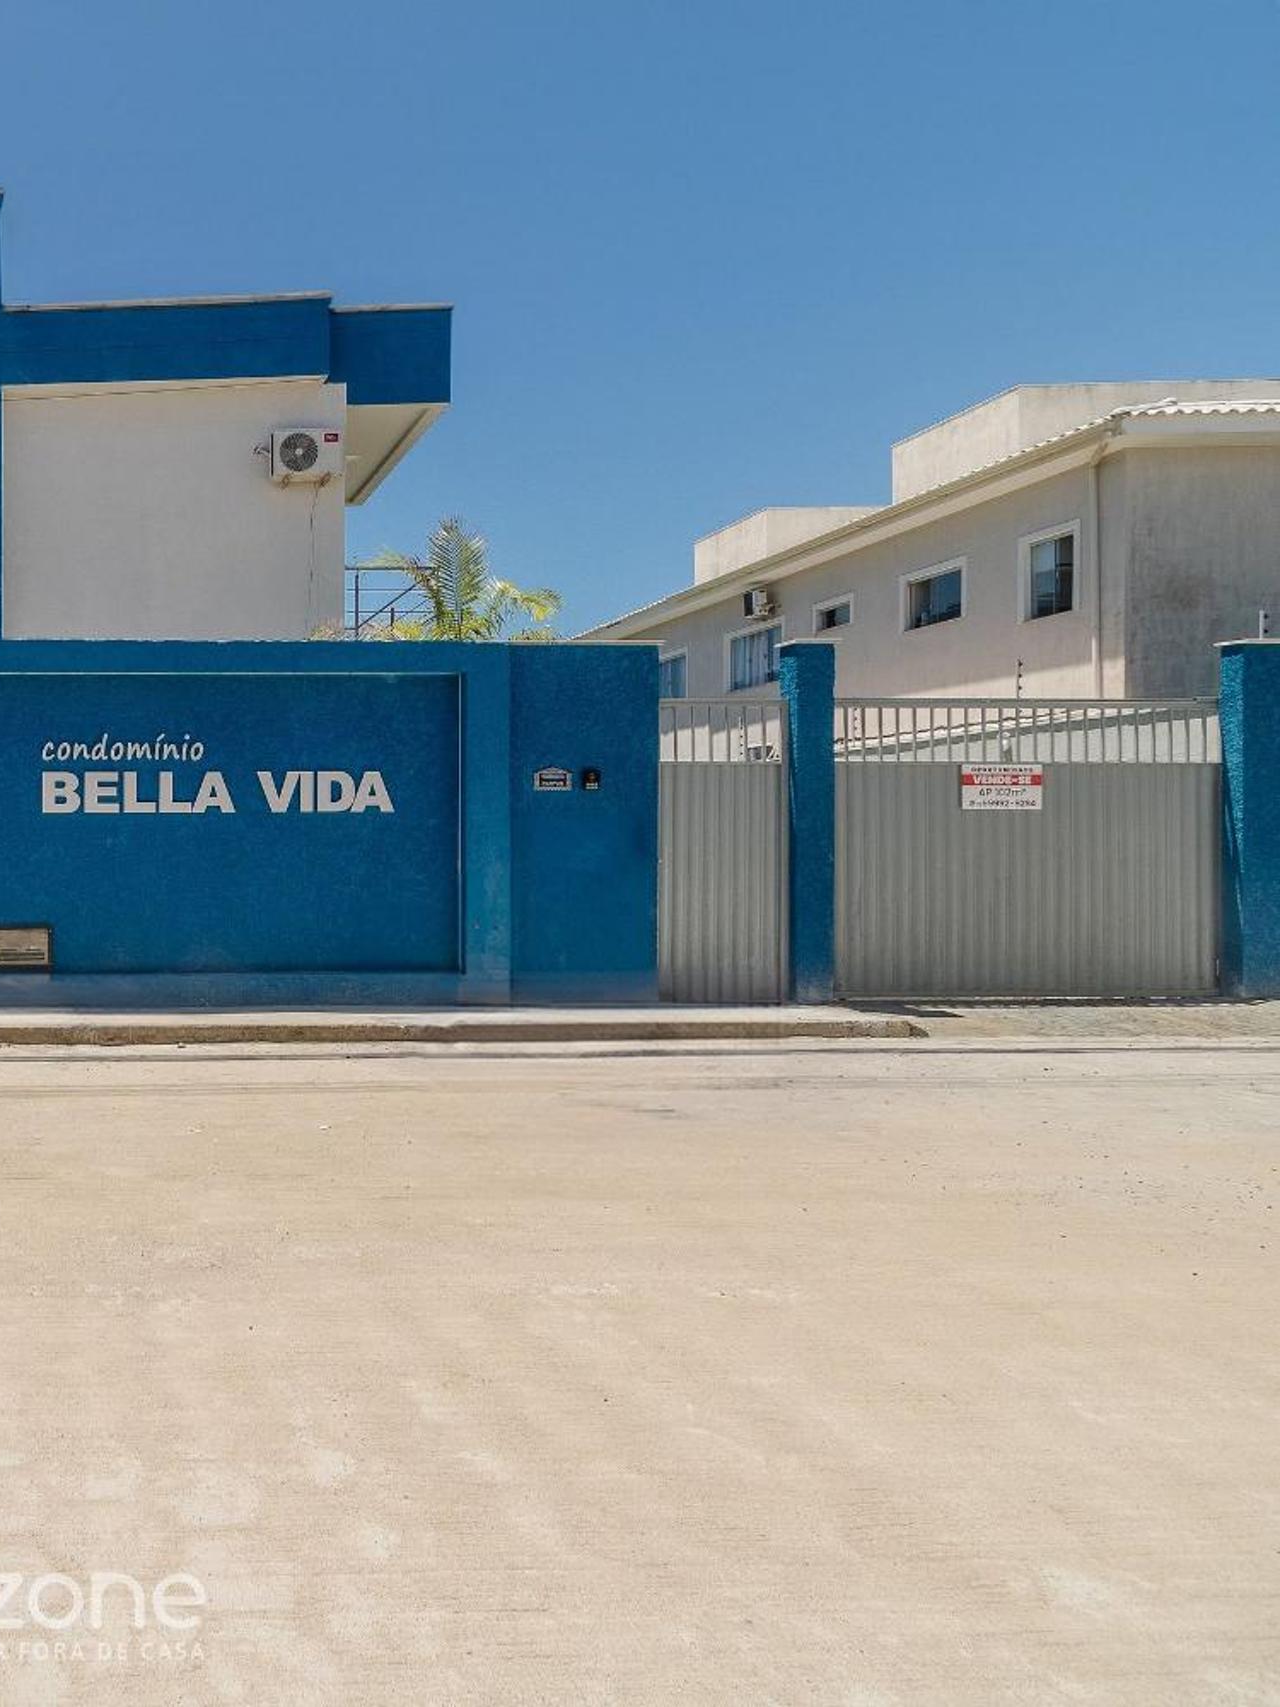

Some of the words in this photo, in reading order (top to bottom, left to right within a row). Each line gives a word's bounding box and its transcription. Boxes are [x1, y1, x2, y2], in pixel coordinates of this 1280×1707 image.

[41, 732, 205, 762] condomínio
[41, 771, 236, 814] BELLA
[256, 771, 395, 814] VIDA
[972, 775, 1032, 784] VENDE-SE
